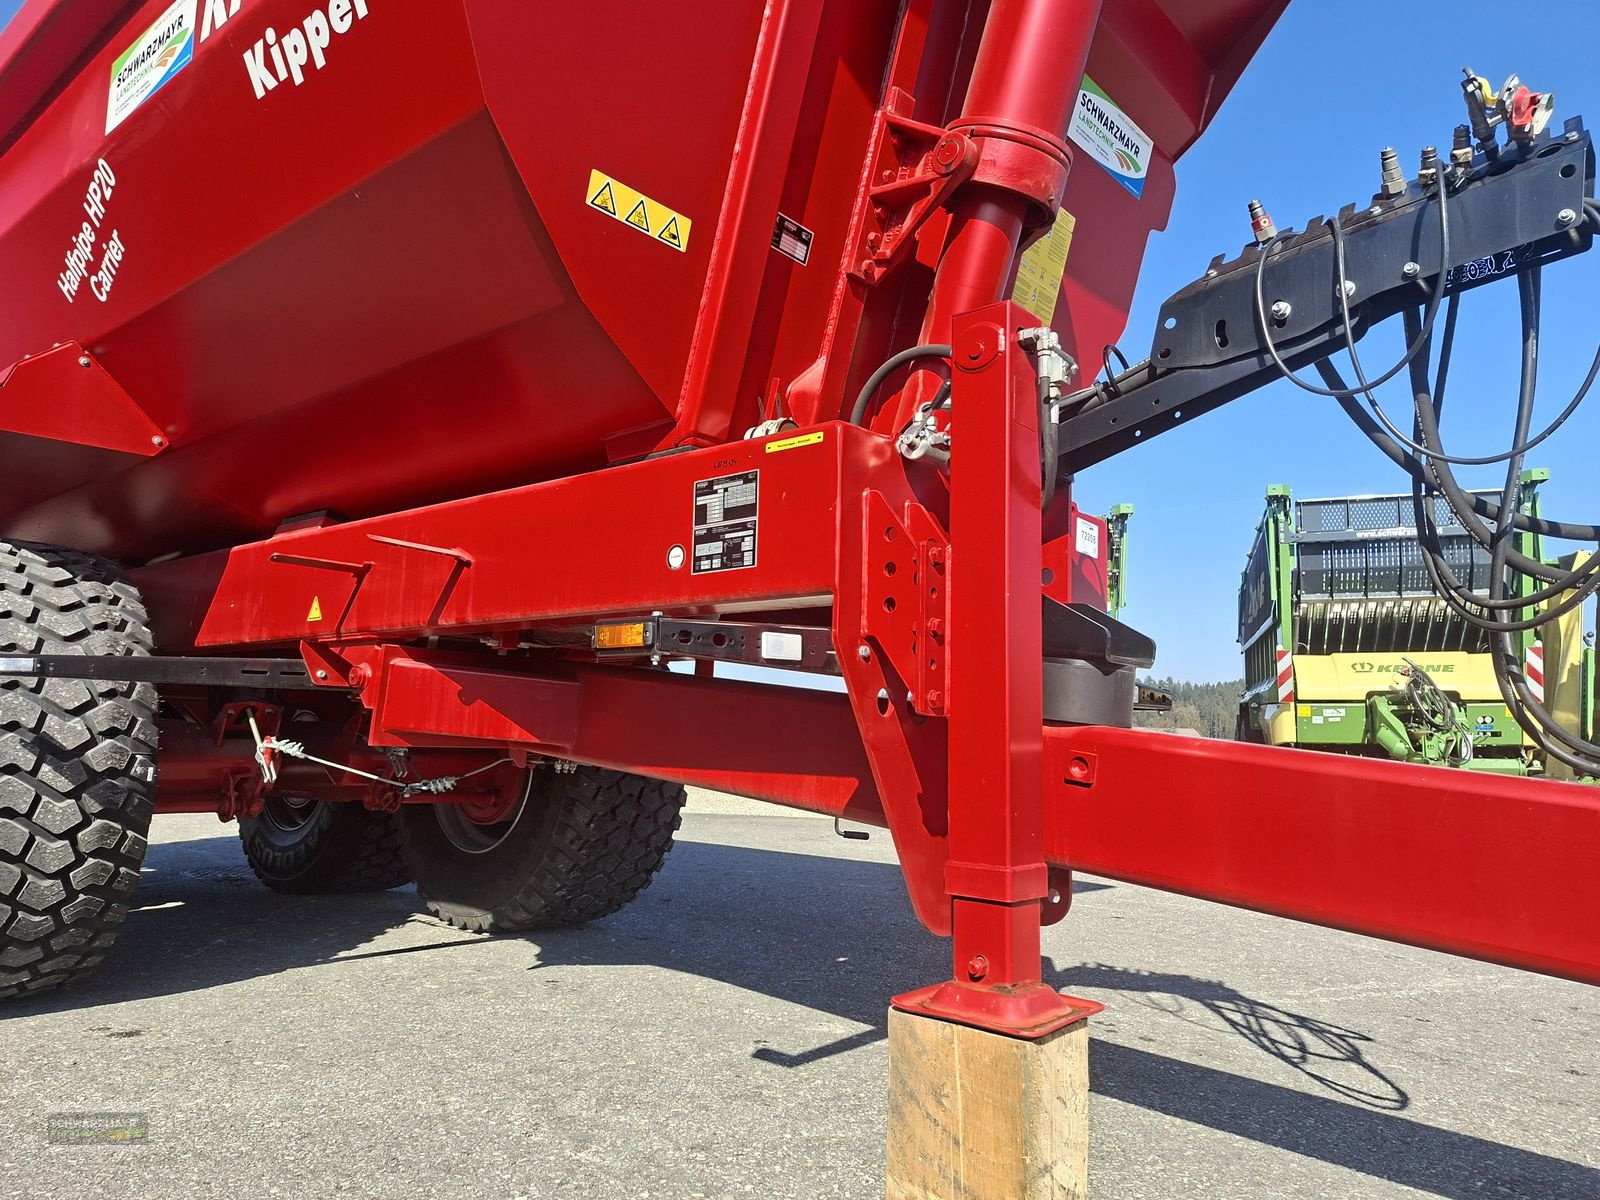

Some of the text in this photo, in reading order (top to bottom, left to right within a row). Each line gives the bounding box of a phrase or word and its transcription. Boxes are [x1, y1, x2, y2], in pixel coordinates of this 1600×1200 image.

[116, 14, 184, 89] SCHWARZMAYR
[1077, 111, 1116, 151] LANDTECHNIK
[1080, 93, 1141, 159] SCHWARZMAYR
[57, 157, 116, 304] Halfpipe HP20
[90, 228, 126, 303] Carrier
[1376, 664, 1456, 673] KRNE
